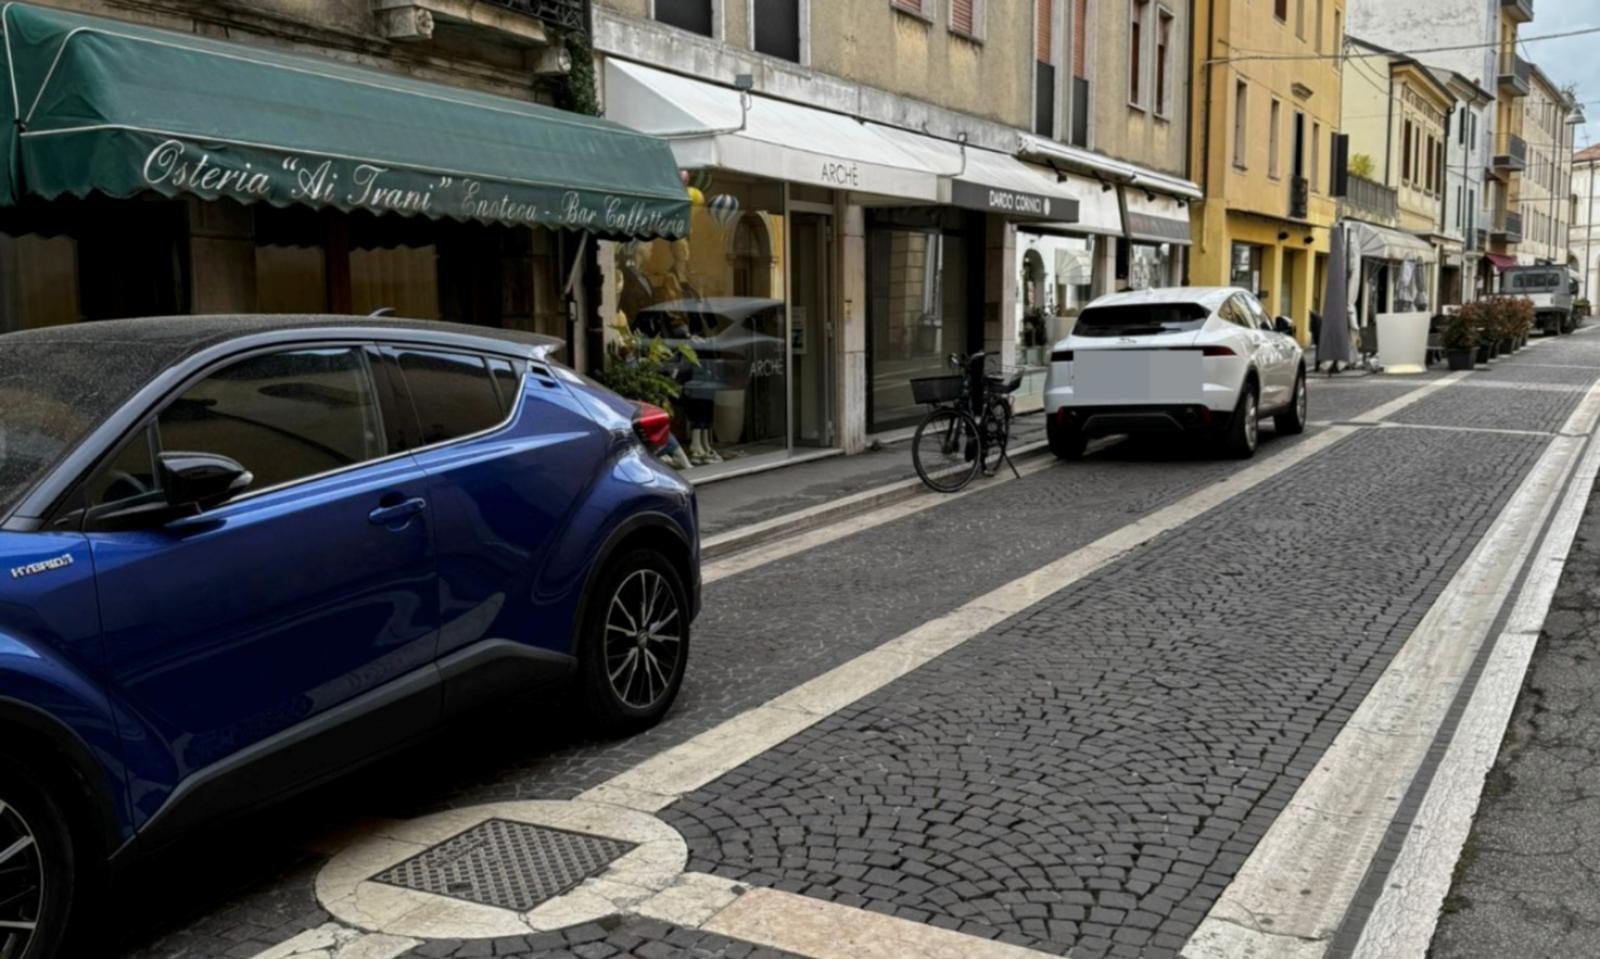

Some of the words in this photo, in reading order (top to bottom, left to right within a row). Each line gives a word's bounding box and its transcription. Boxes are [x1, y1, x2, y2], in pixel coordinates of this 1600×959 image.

[143, 139, 270, 193] Osteria
[462, 178, 538, 219] Enoteca
[557, 190, 597, 224] Bar
